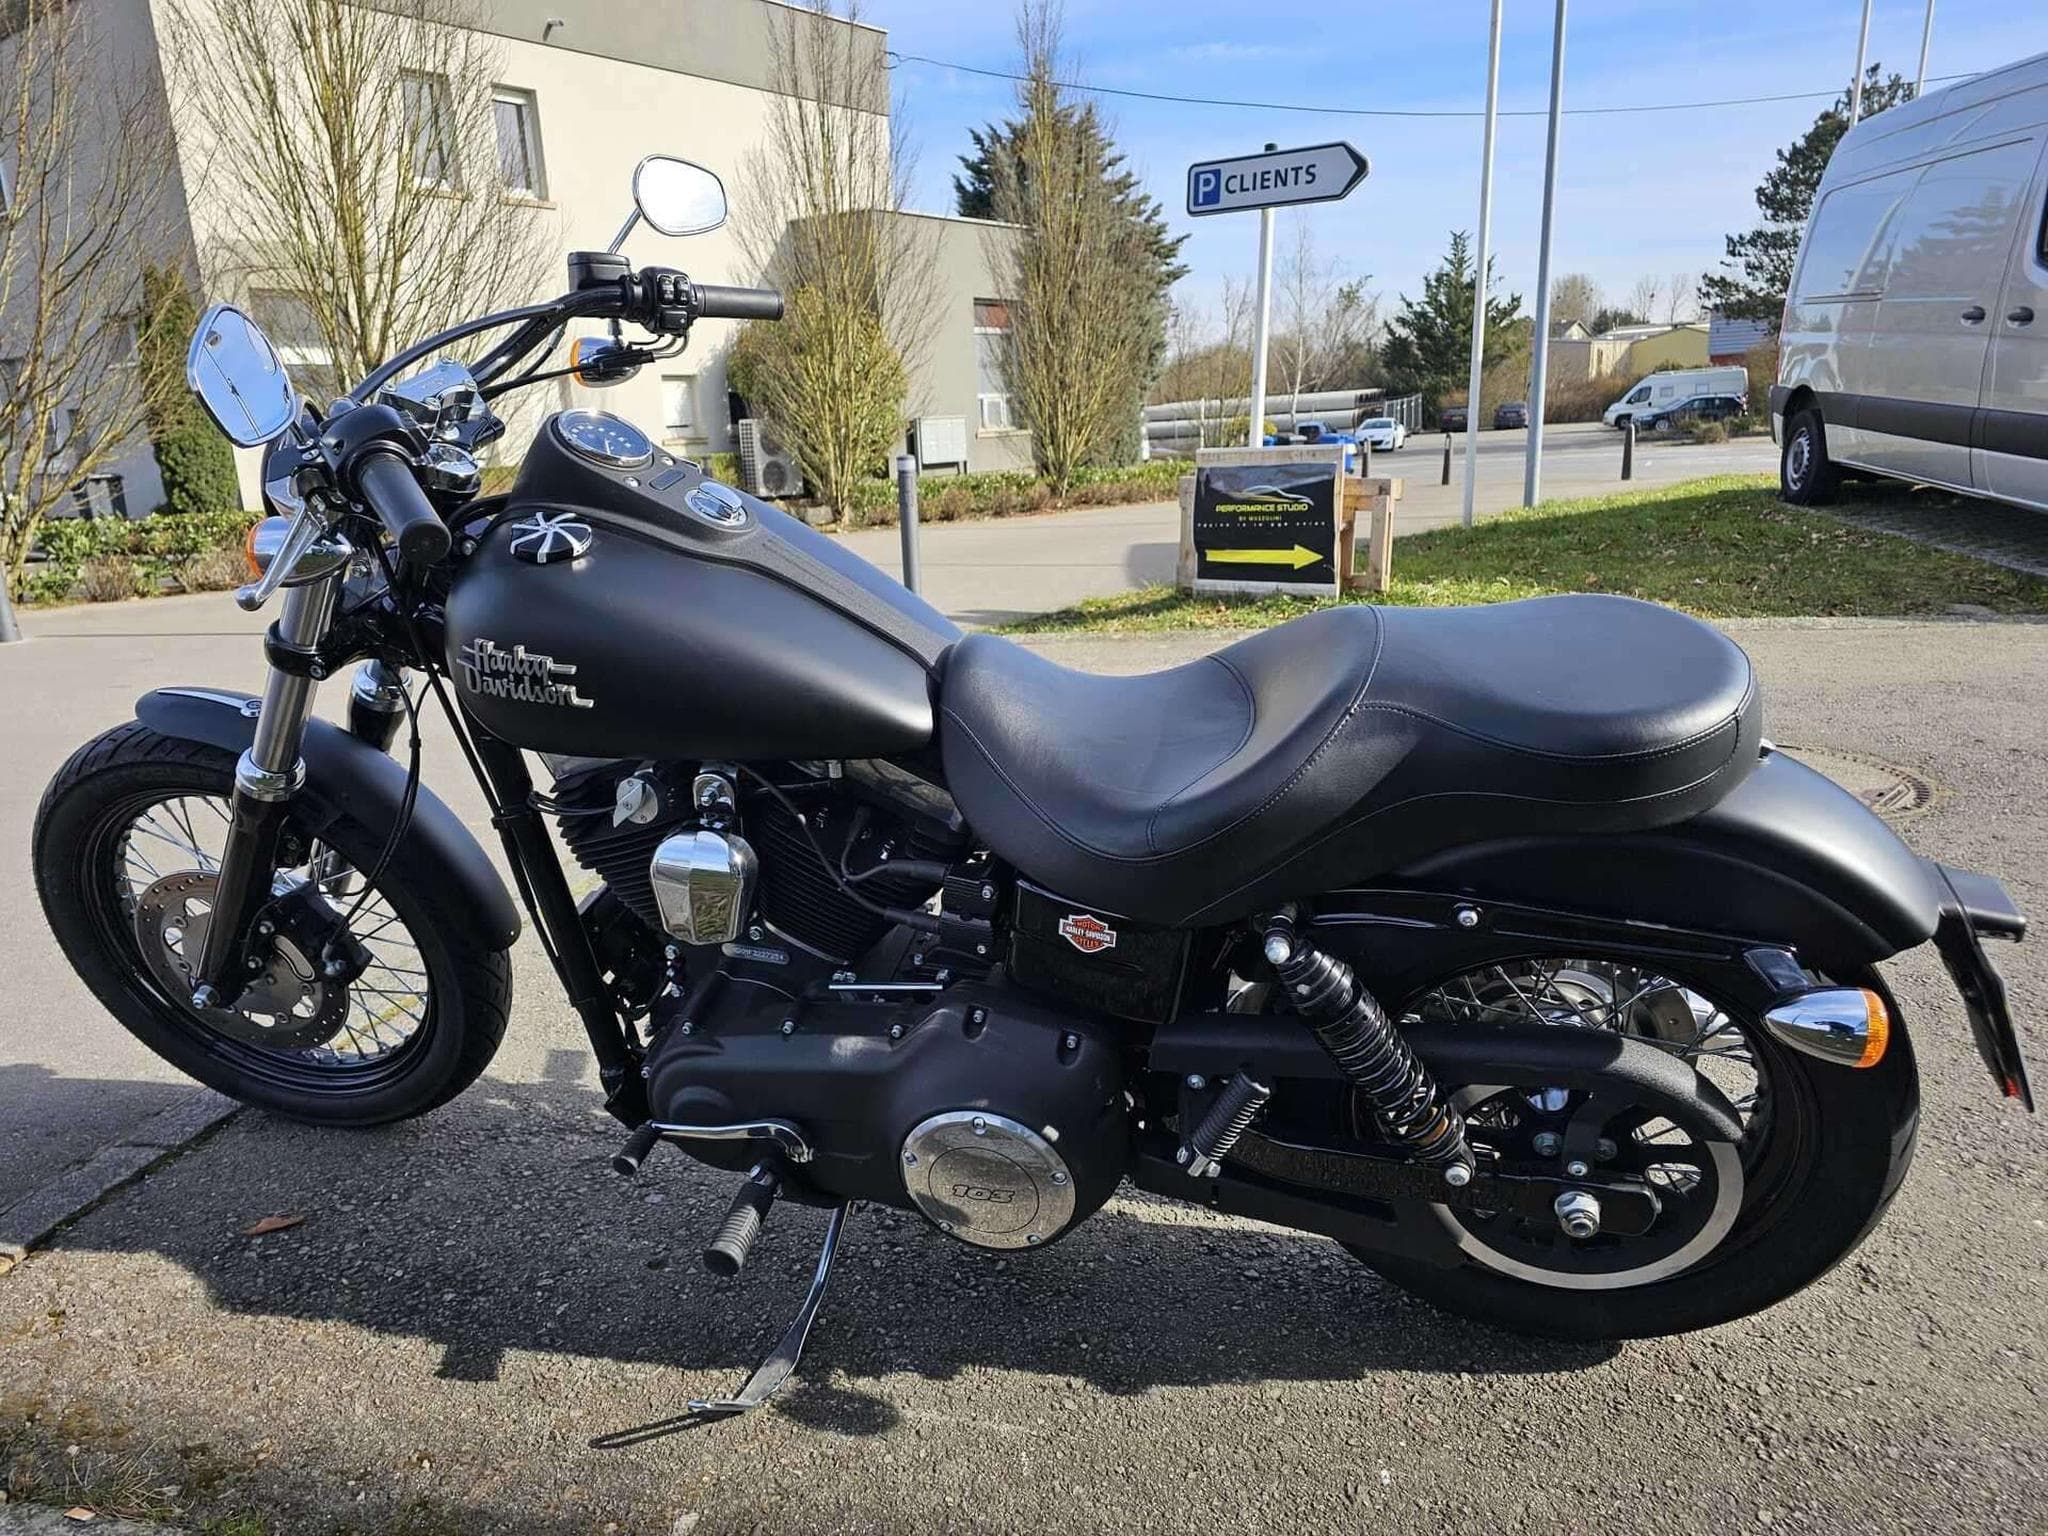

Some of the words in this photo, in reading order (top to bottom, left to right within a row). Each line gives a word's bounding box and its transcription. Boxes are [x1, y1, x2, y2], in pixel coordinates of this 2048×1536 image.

[1199, 172, 1216, 204] P
[1225, 164, 1317, 194] CLIENTS
[1215, 503, 1275, 513] PERFORMANCE
[1277, 503, 1309, 512] STUDIO
[462, 638, 577, 682] Harley
[456, 658, 594, 708] Davidson
[952, 1184, 1016, 1204] 103
